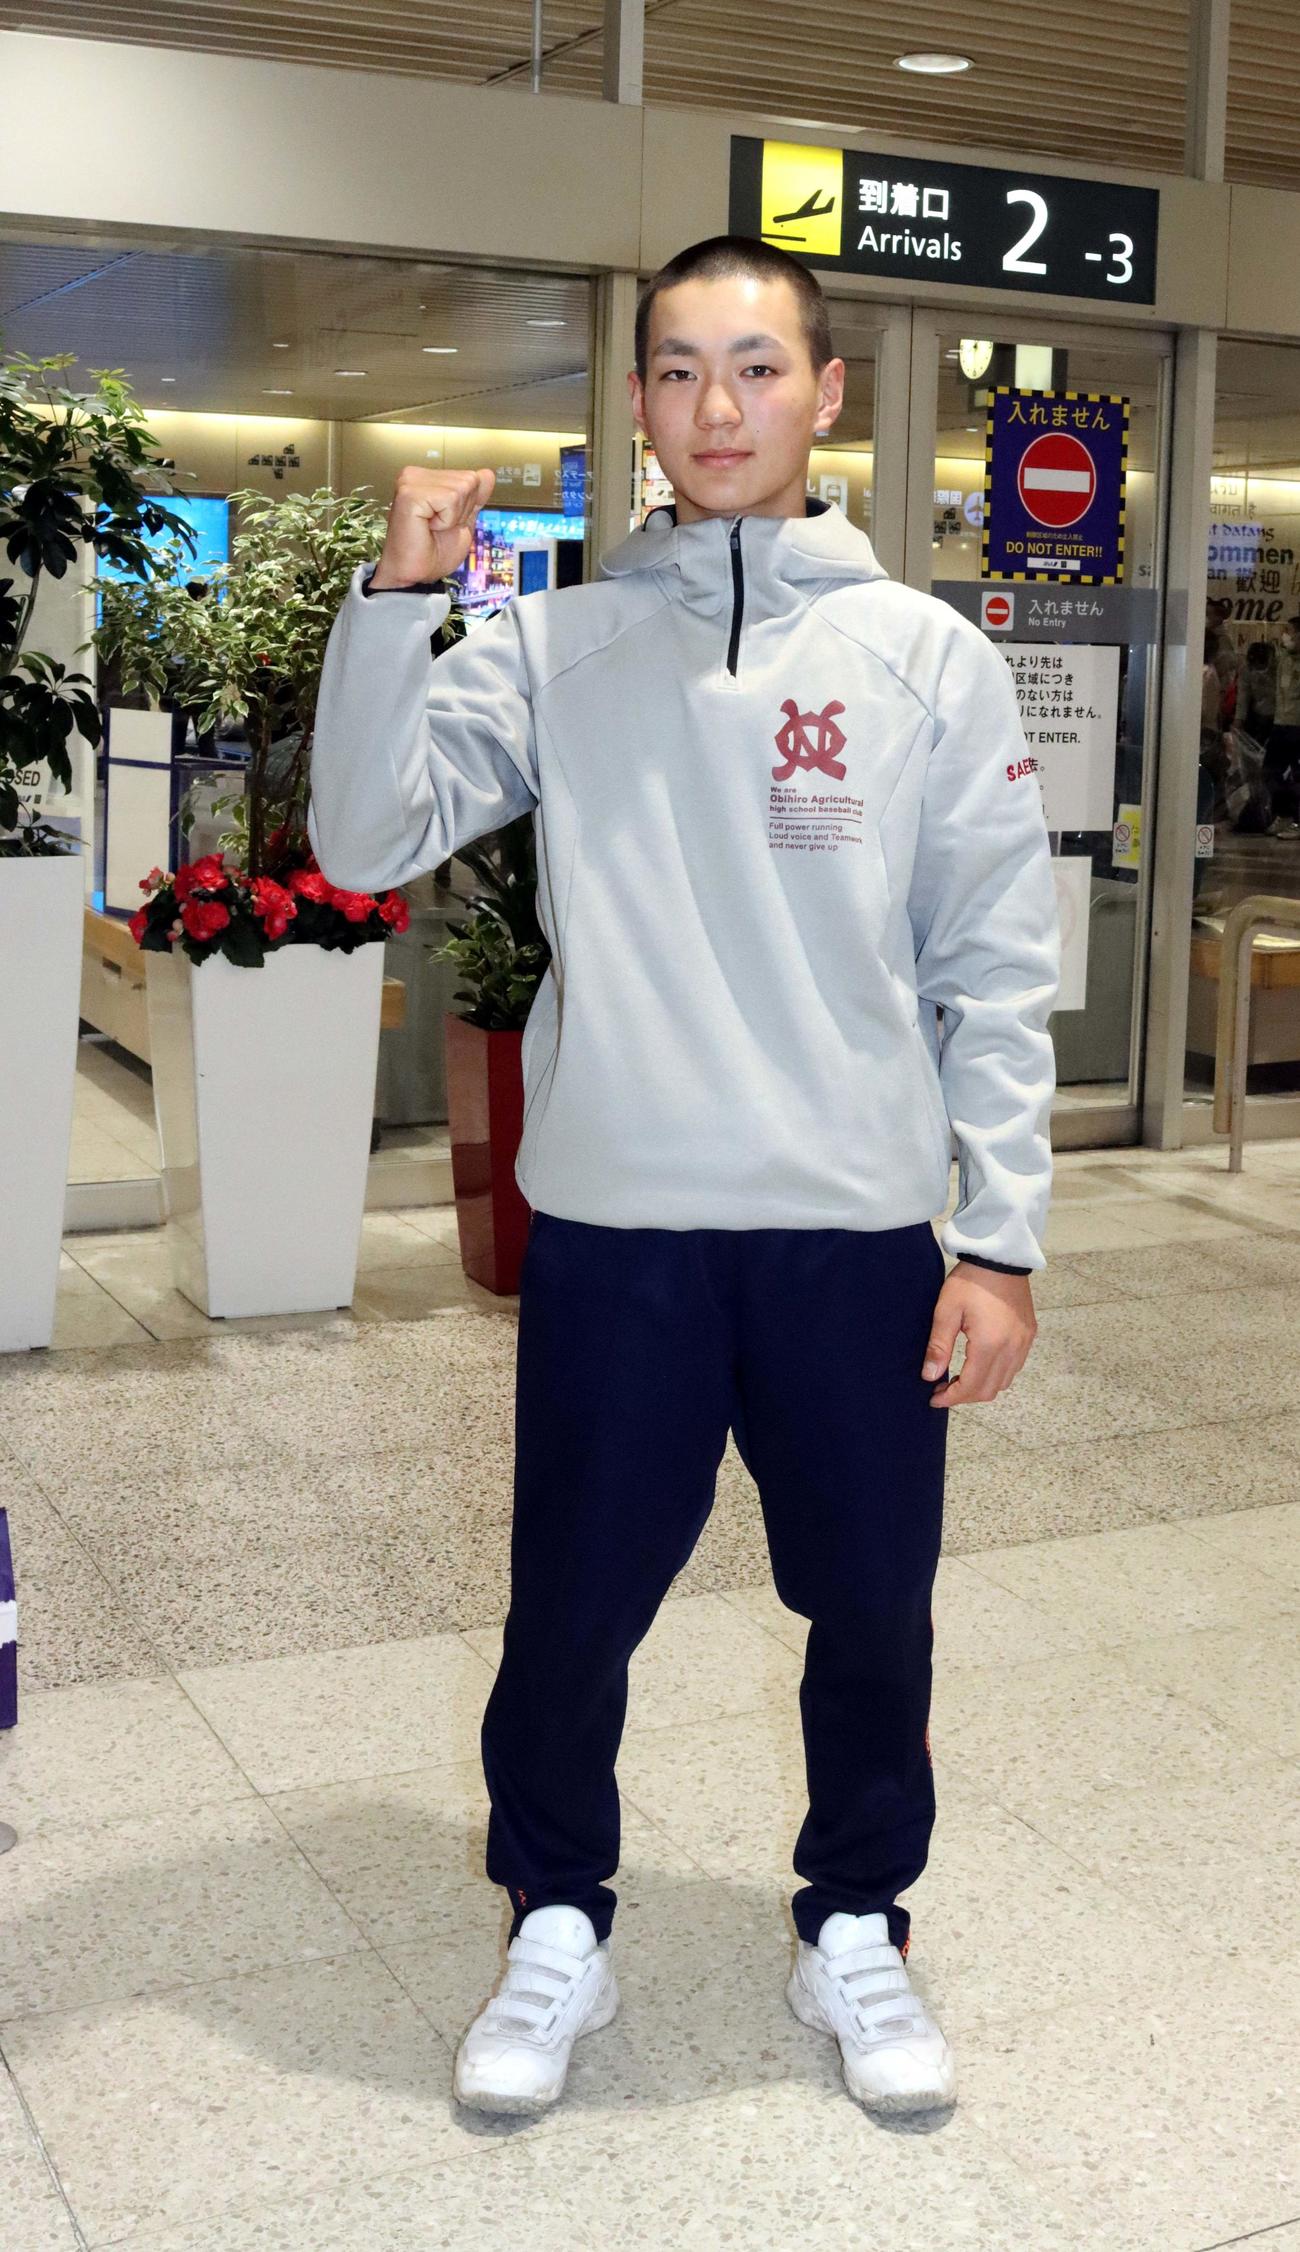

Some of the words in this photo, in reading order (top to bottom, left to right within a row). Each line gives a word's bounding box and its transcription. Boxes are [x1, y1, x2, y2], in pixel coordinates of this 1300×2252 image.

[858, 178, 950, 221] 到着口
[1002, 189, 1049, 275] 2
[857, 225, 962, 261] Arrivals
[1007, 401, 1111, 431] 入れません
[1006, 541, 1024, 554] DO
[1027, 542, 1053, 555] NOT
[1056, 544, 1103, 557] ENTER!!
[1028, 599, 1104, 617] 入れません
[1028, 617, 1041, 626] No
[1043, 617, 1067, 628] Entry
[1012, 672, 1074, 685] 区域につき
[1016, 689, 1074, 702] のない方は
[1039, 732, 1081, 743] ENTER.
[770, 794, 808, 804] Obihiro
[811, 795, 864, 807] Agricultural
[769, 822, 784, 830] Full
[785, 824, 810, 832] power
[812, 824, 843, 832] running
[769, 832, 789, 840] Loud
[831, 834, 863, 844] Teamwork
[809, 843, 826, 851] give
